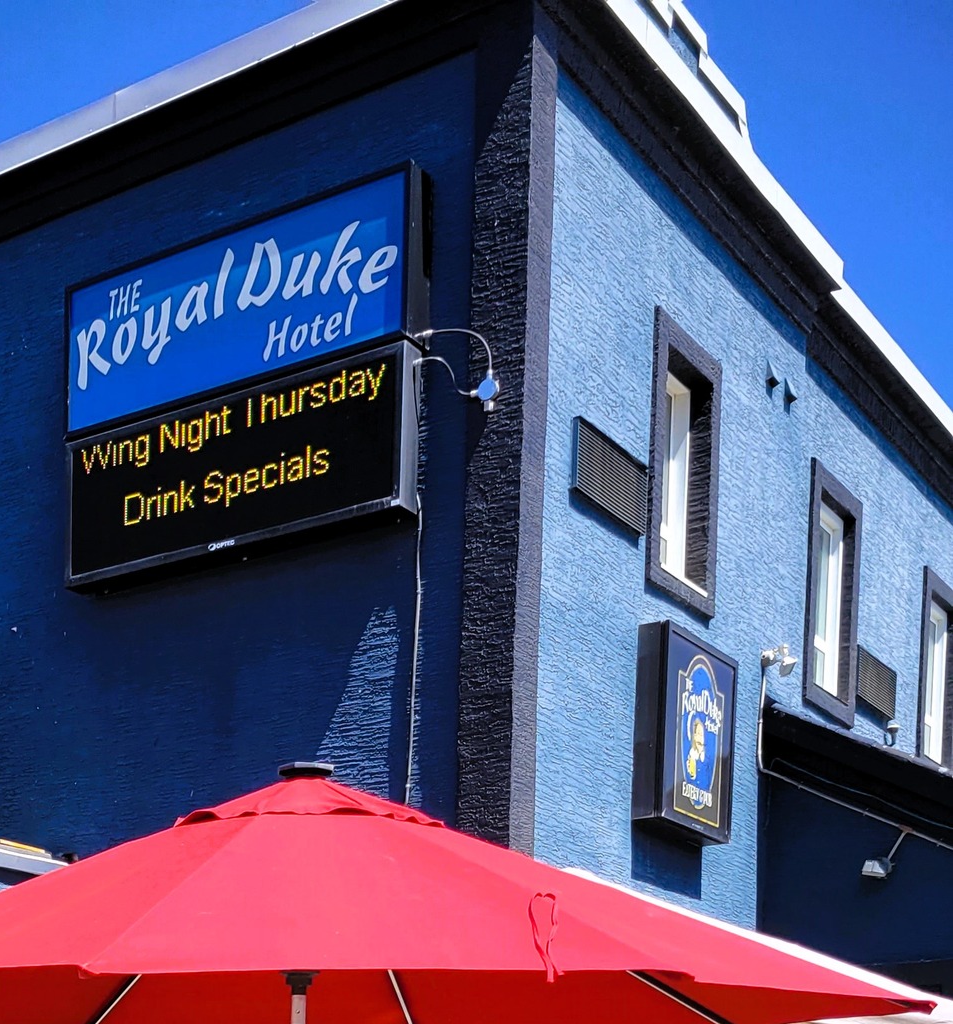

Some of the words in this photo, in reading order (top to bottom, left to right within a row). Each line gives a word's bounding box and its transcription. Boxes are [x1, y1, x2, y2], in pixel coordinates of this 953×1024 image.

[76, 248, 235, 391] Royal
[236, 220, 398, 311] Duke
[109, 278, 143, 321] THE
[262, 292, 358, 363] Hotel
[159, 405, 232, 453] Night
[246, 363, 387, 428] Thursday
[123, 480, 196, 527] Drink
[203, 445, 330, 508] Specials
